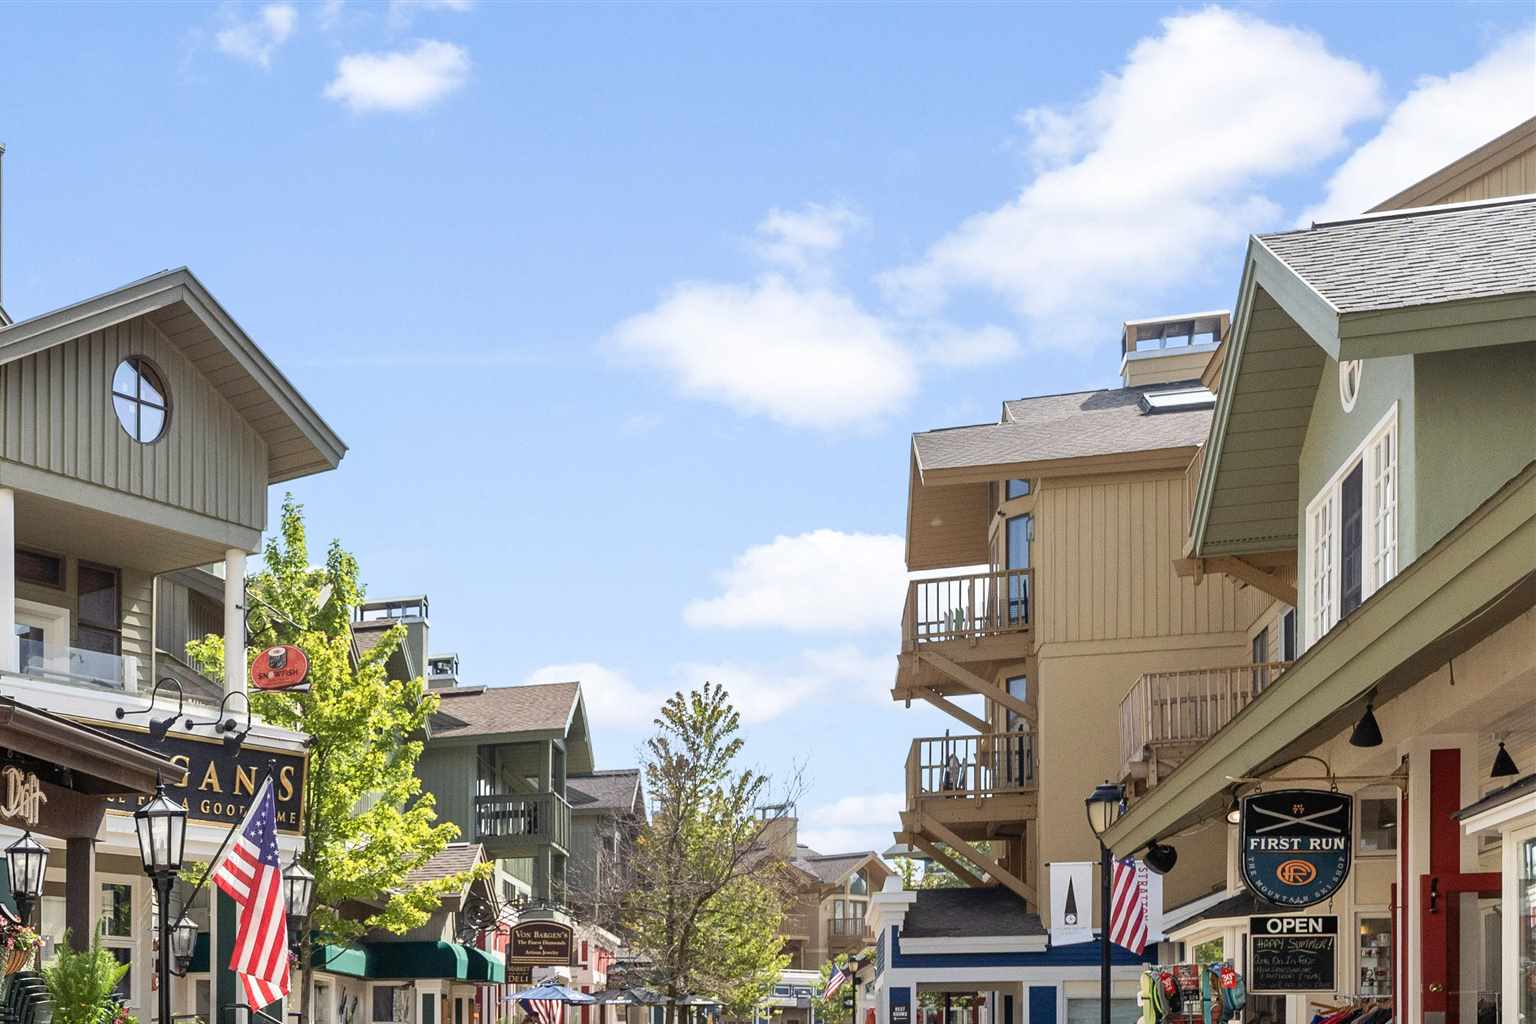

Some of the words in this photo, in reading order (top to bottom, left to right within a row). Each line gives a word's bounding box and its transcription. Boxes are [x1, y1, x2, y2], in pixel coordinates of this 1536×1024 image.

[1250, 838, 1302, 850] FIRST
[1309, 837, 1345, 850] RUN
[1248, 857, 1257, 877] THE
[1255, 880, 1310, 904] MOUNTAIN
[1314, 884, 1332, 898] SKI
[1333, 856, 1345, 884] SHOP
[1267, 918, 1323, 933] OPEN
[508, 975, 529, 983] DELI
